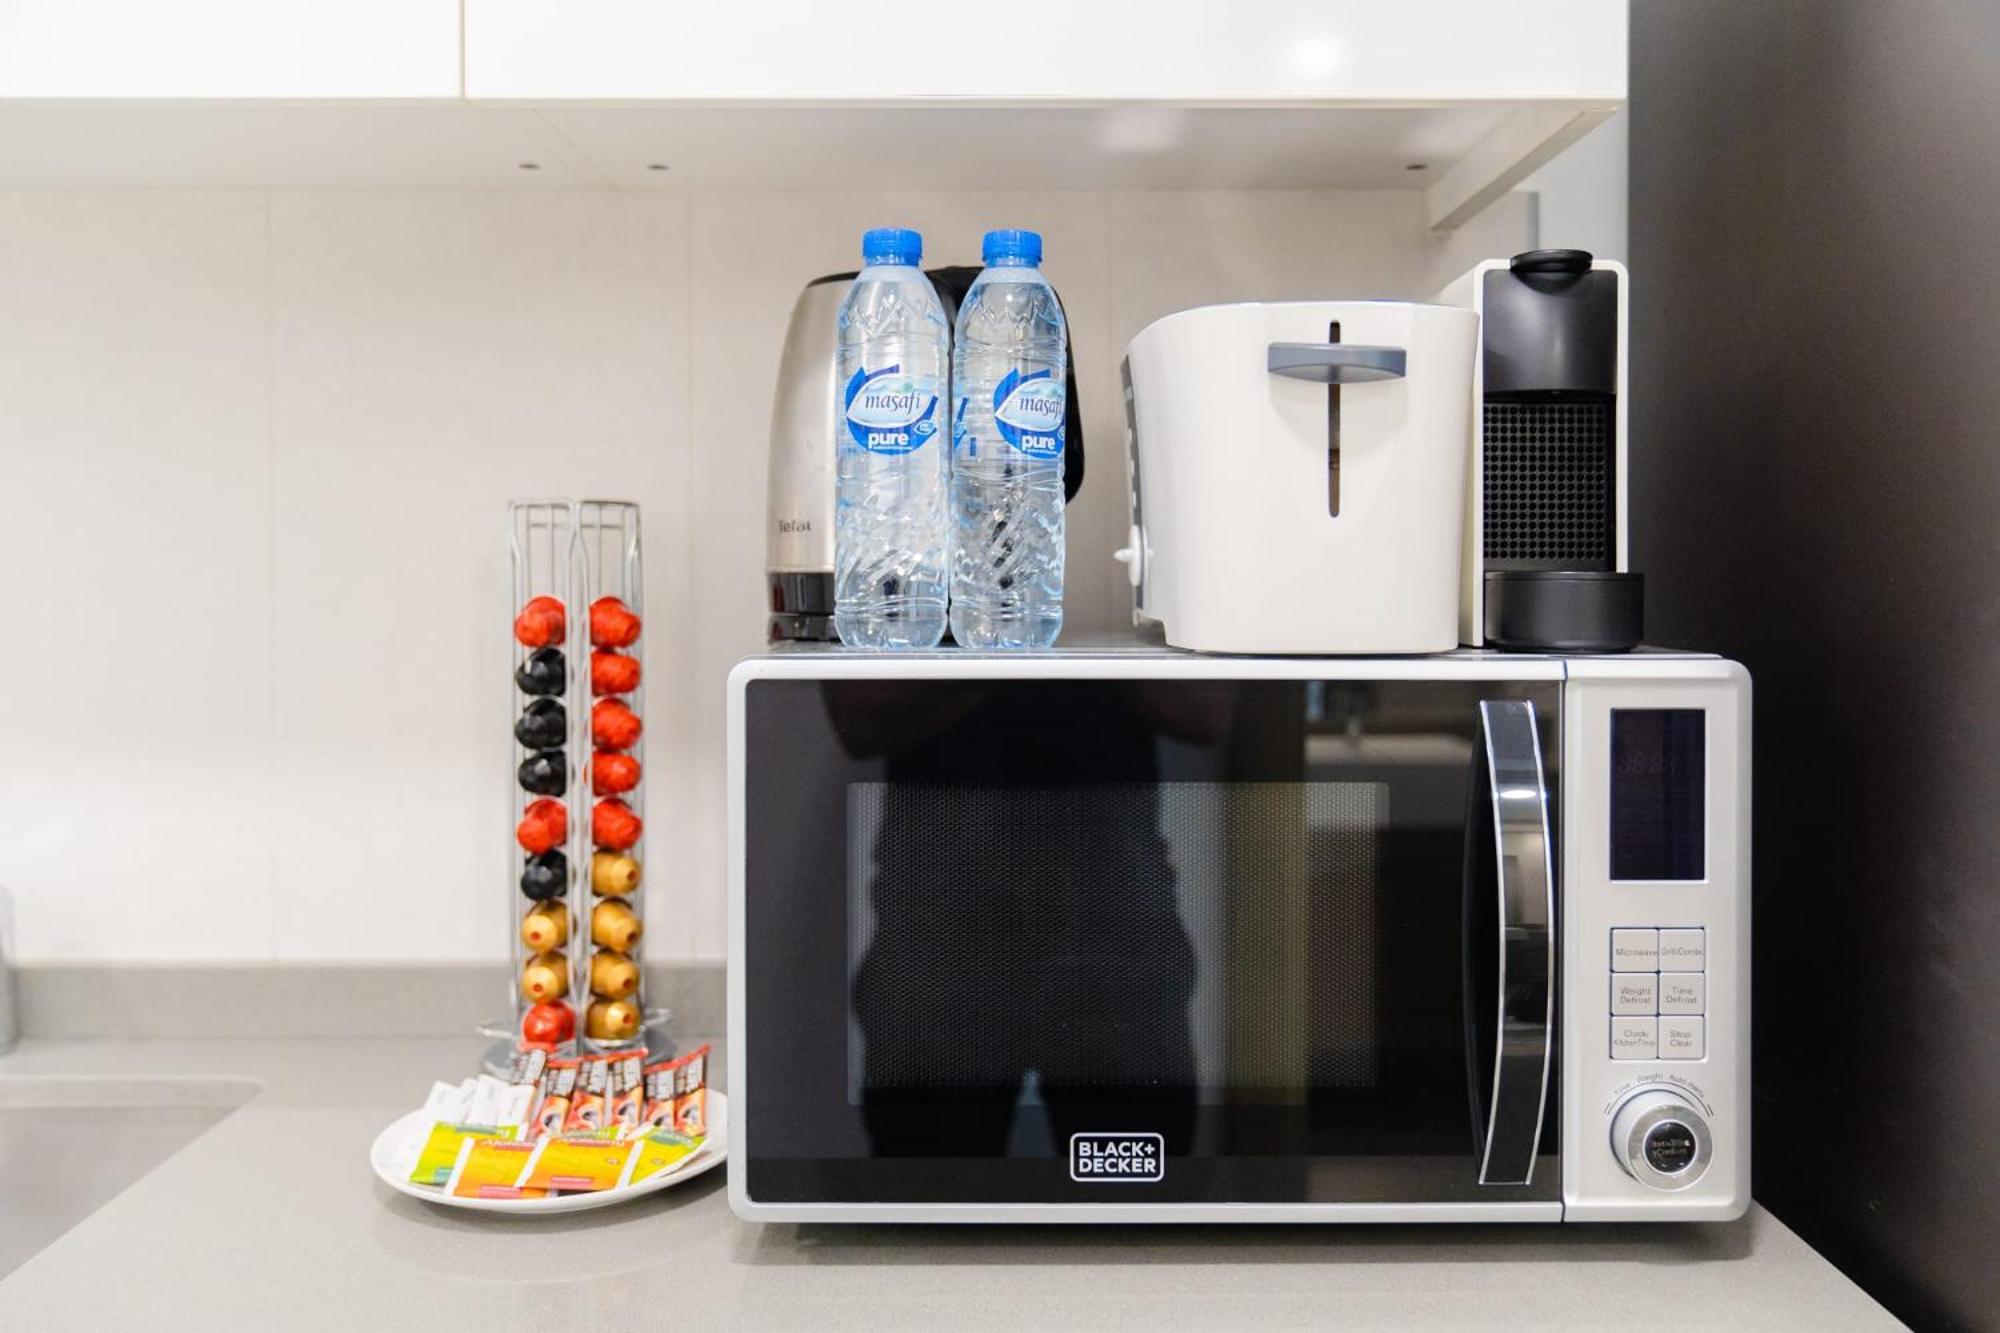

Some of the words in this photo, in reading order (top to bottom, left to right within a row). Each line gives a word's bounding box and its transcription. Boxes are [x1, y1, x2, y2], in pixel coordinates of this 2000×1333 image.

[865, 391, 921, 415] masafi
[868, 433, 909, 449] pure
[1022, 435, 1056, 451] pure
[1078, 1141, 1156, 1157] BLACK+
[1078, 1157, 1157, 1173] DECKER
